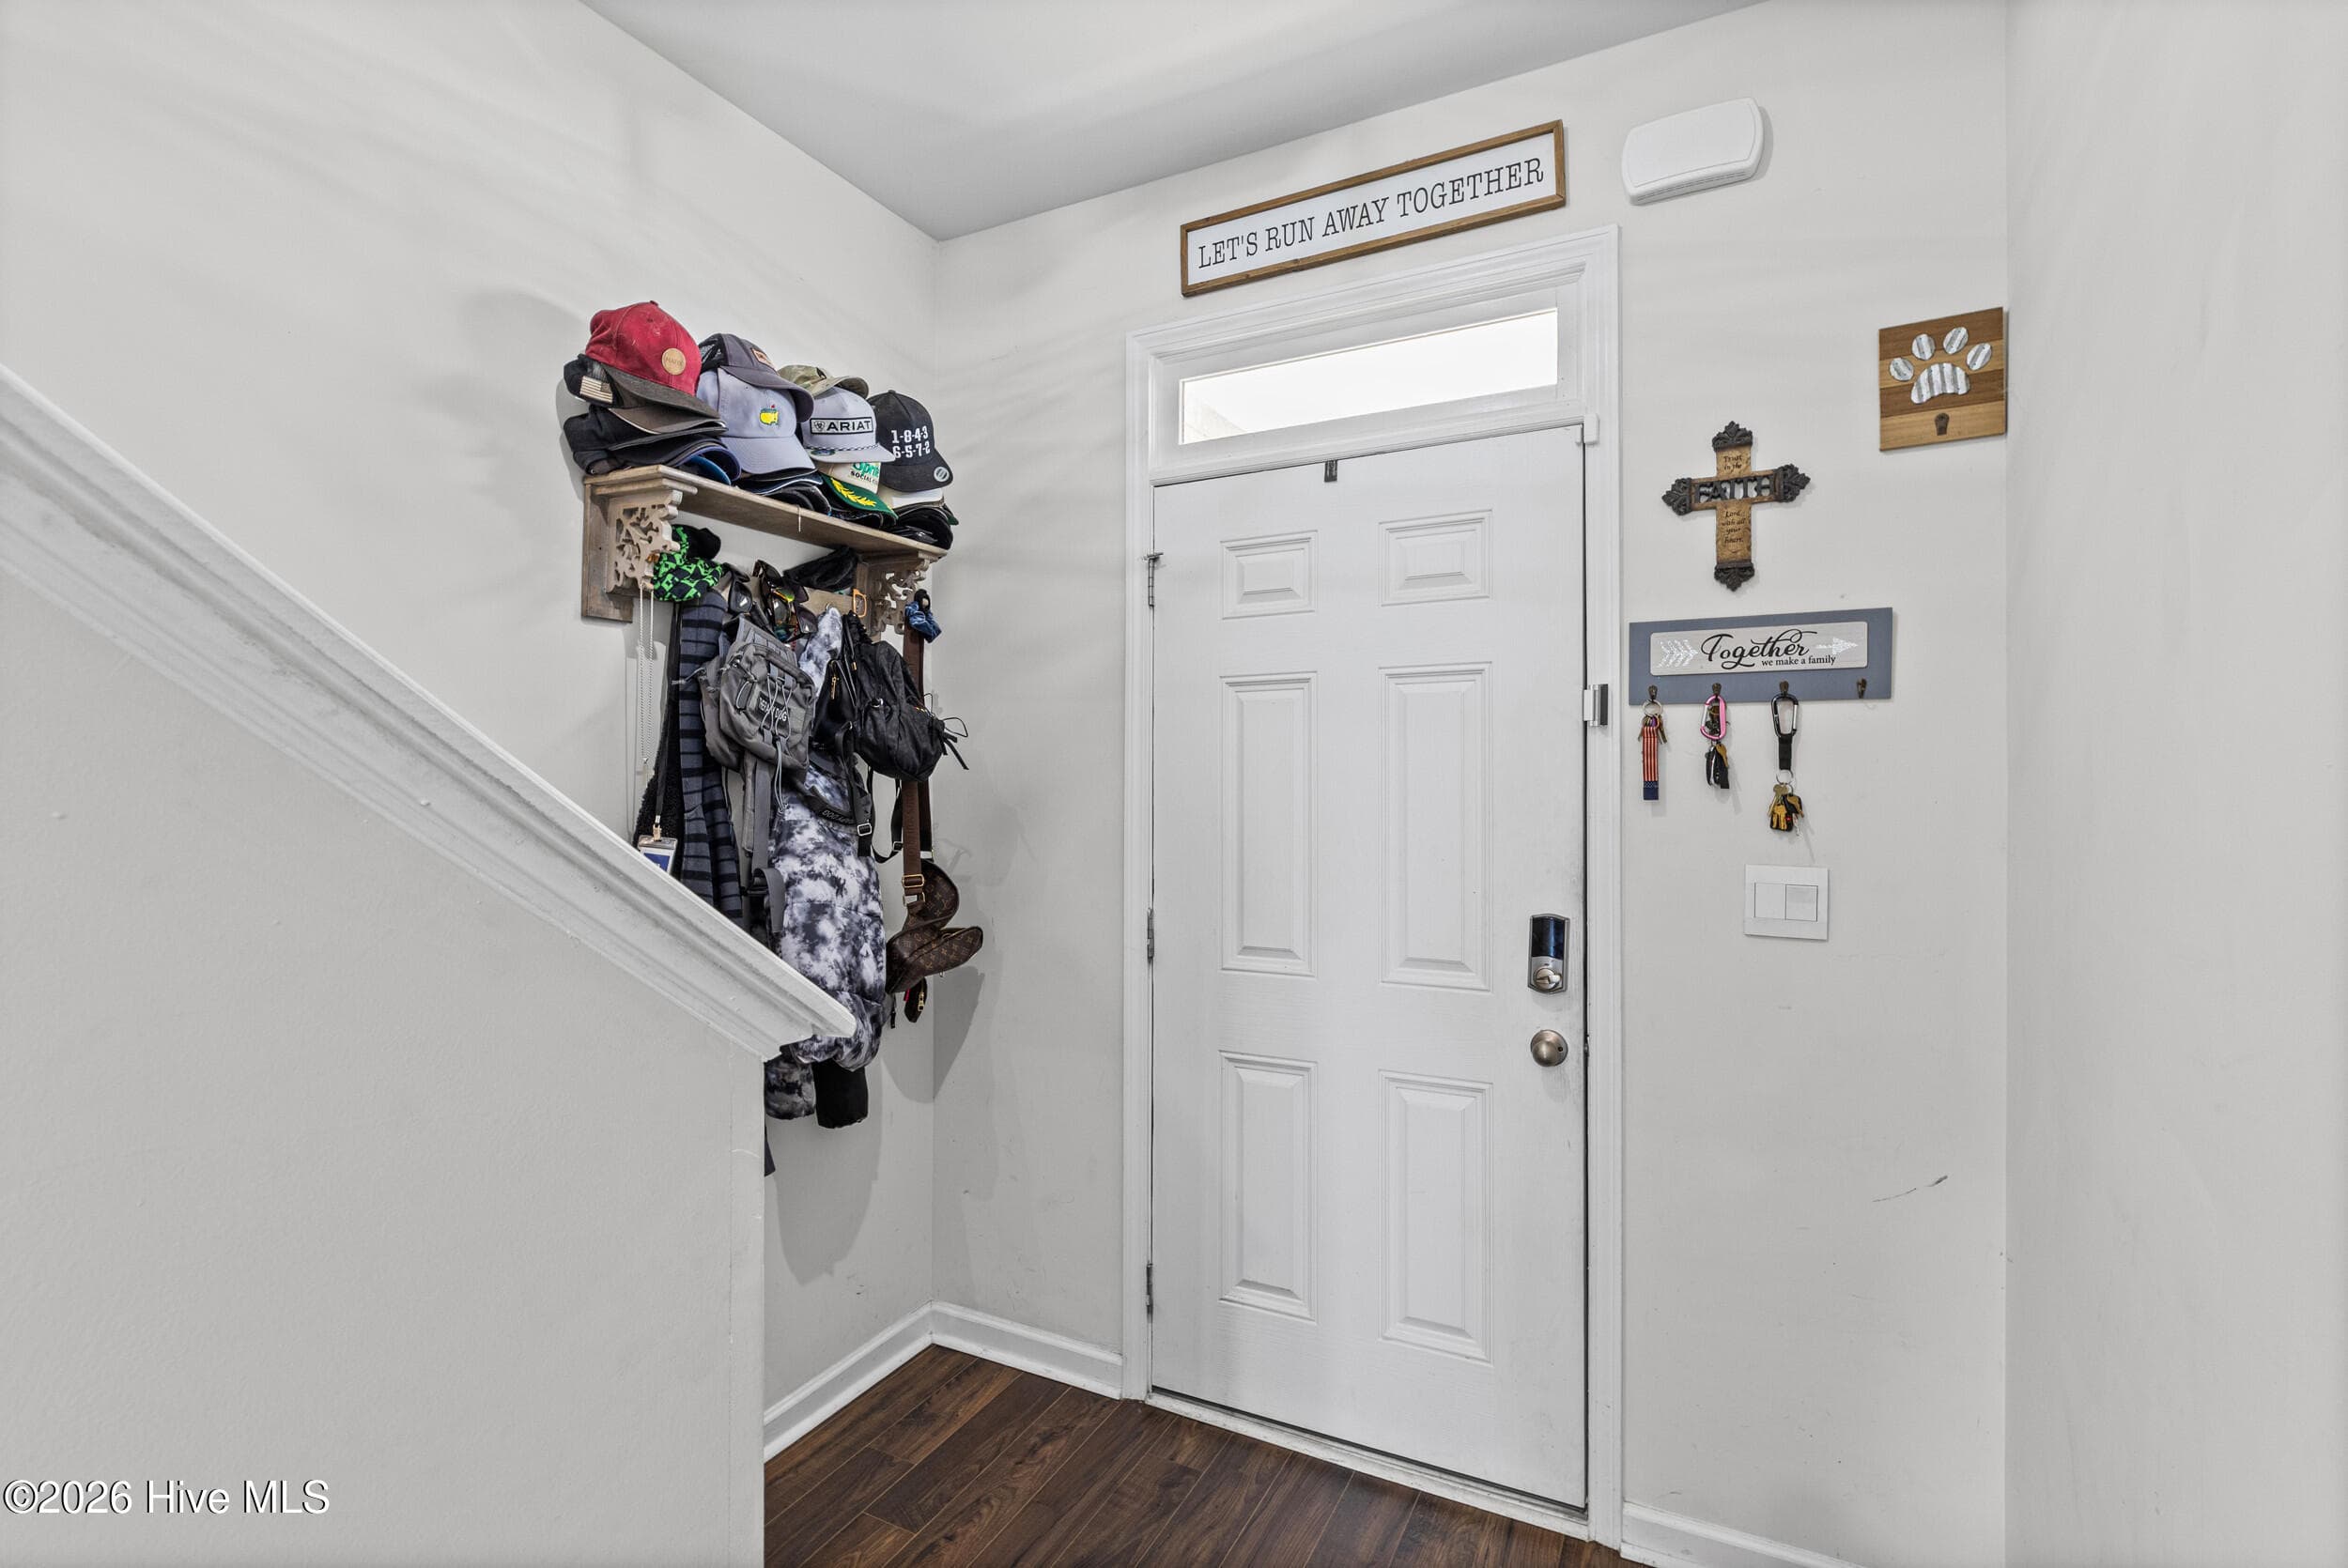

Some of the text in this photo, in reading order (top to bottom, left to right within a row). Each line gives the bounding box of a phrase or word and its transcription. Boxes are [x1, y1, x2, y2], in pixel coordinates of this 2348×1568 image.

[1197, 156, 1545, 269] LET'S RUN AWAY TOGETHER
[826, 420, 872, 432] ARIAT
[890, 424, 929, 444] 1-8-4-3
[891, 439, 931, 459] 6-5-7-2
[1695, 475, 1774, 504] FAITH
[1701, 629, 1817, 669] Together
[1775, 656, 1800, 666] make
[1808, 654, 1836, 666] family
